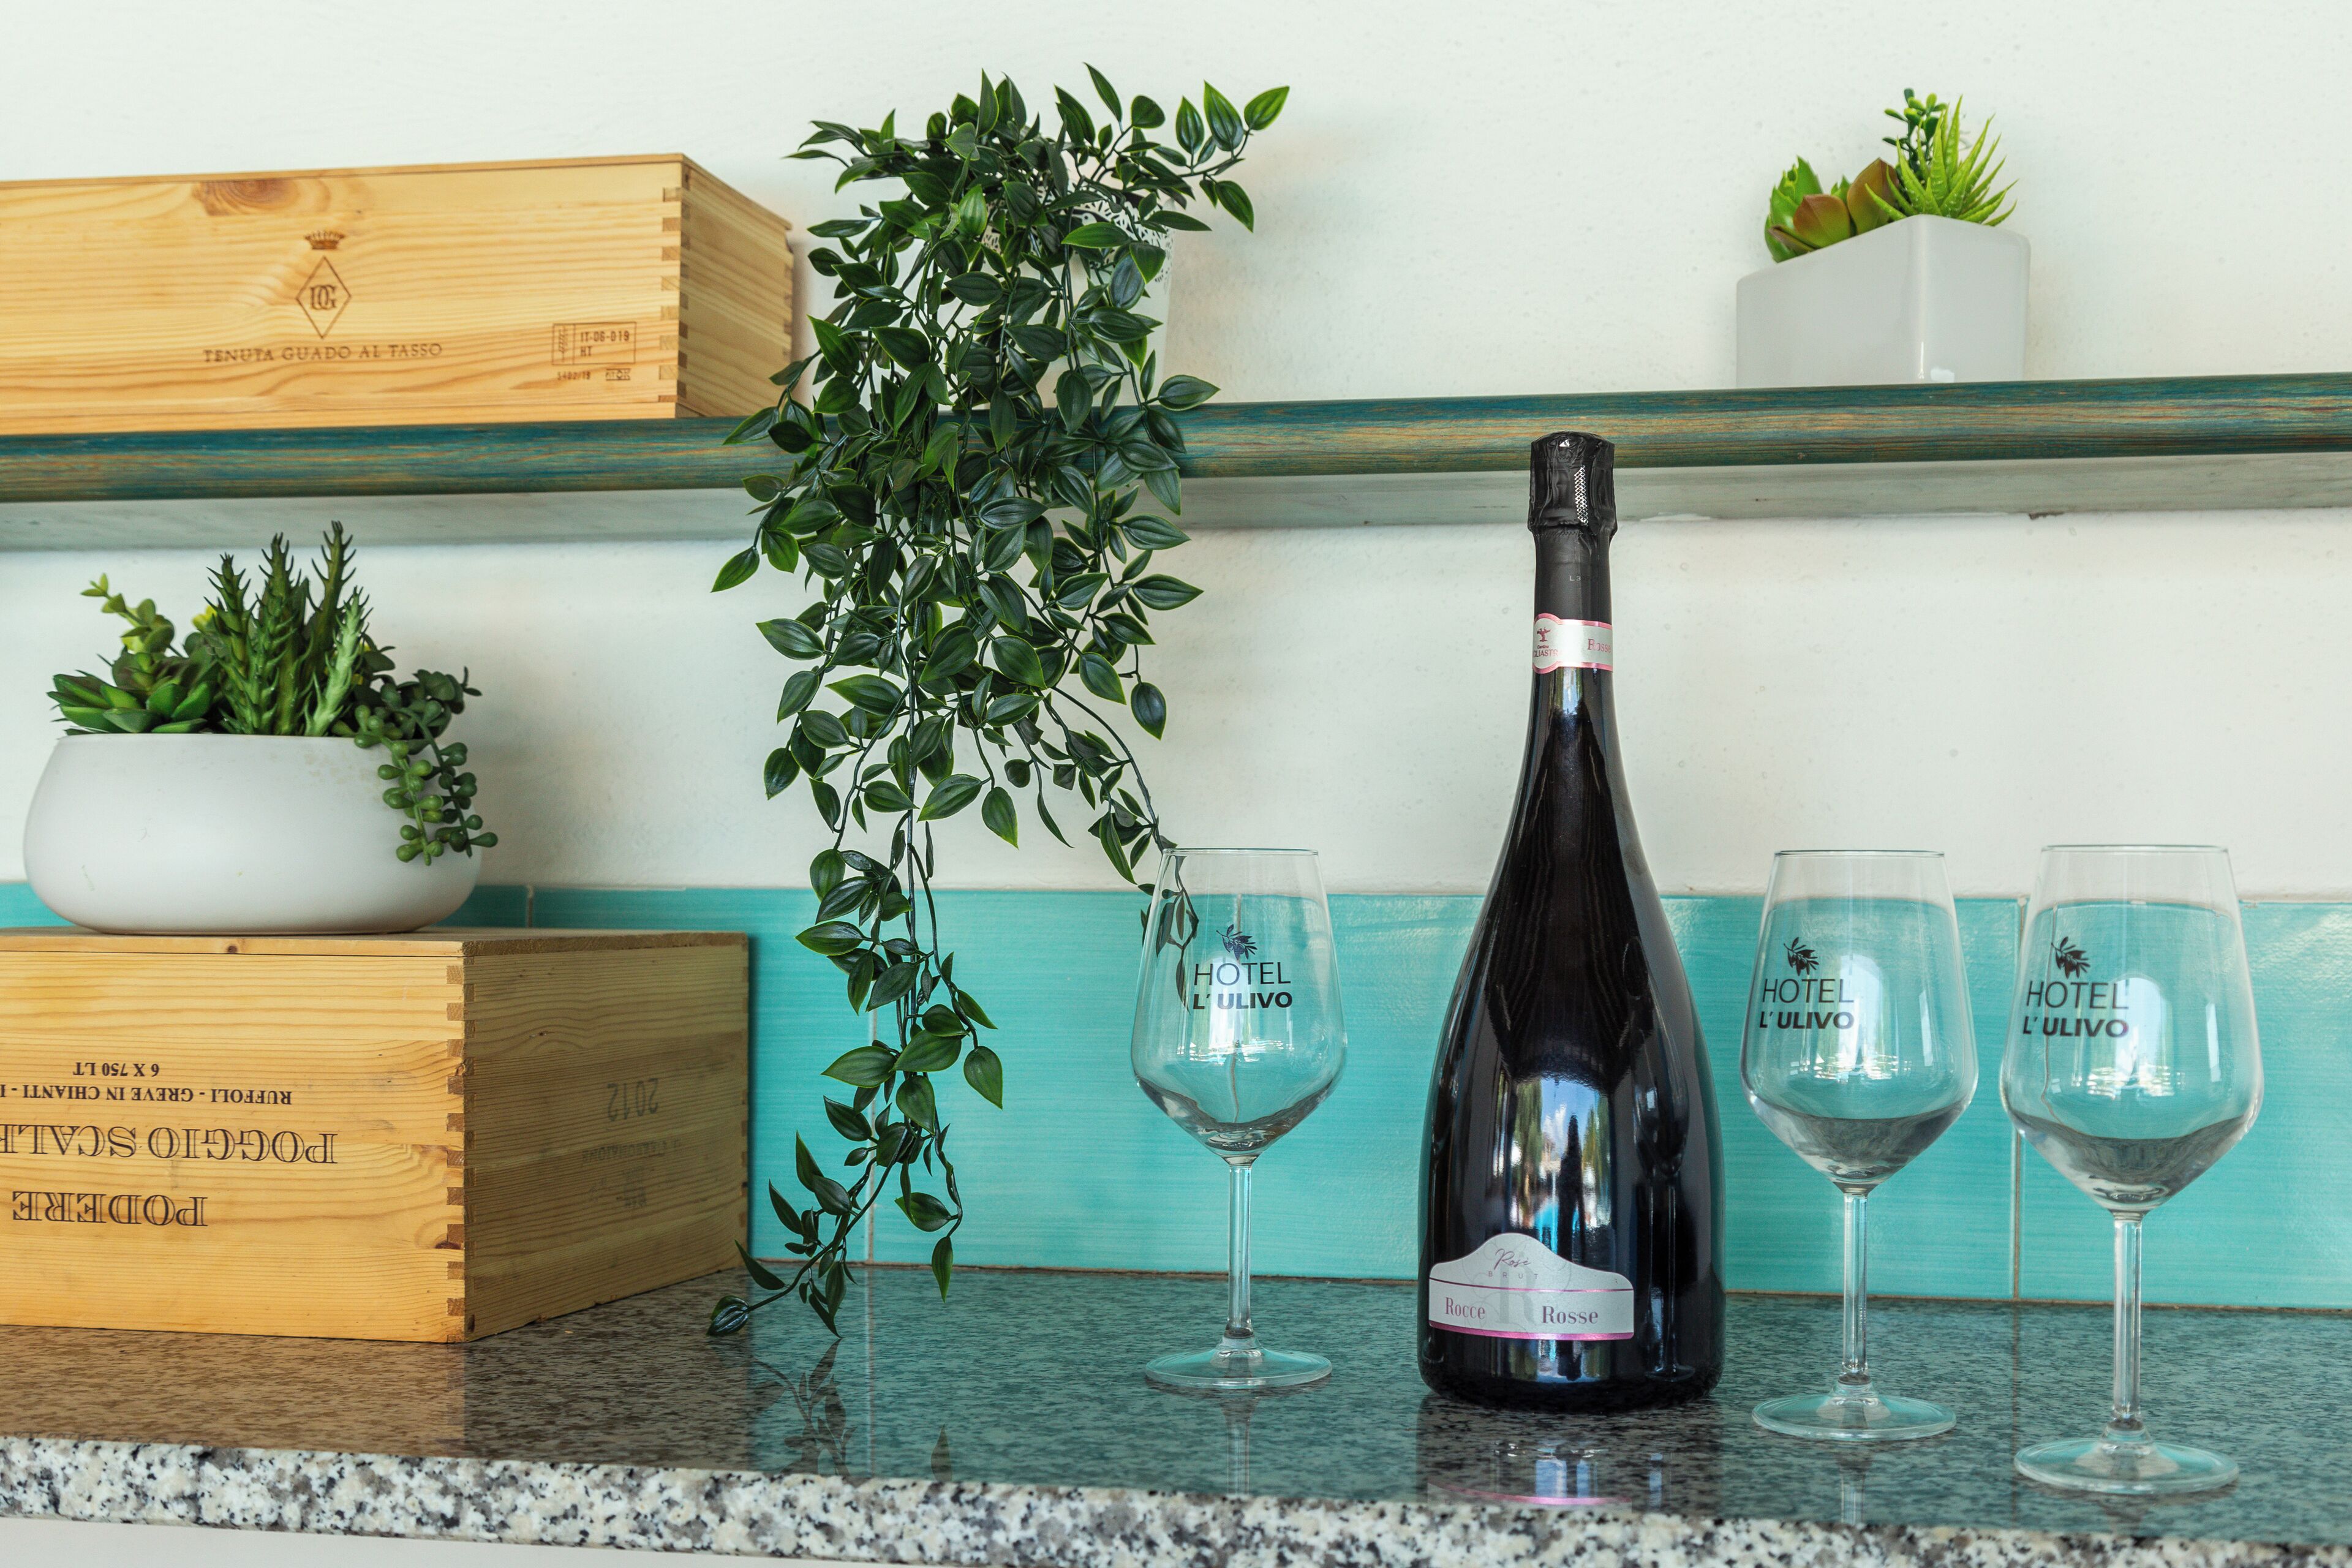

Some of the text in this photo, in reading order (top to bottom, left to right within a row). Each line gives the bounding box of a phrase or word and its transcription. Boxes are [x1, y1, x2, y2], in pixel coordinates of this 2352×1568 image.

[203, 343, 443, 362] TENUTA GUADO AL TASSO
[581, 345, 592, 356] HT
[1194, 962, 1291, 986] HOTEL
[1762, 979, 1854, 1003] HOTEL
[2026, 980, 2129, 1009] HOTEL
[72, 1061, 159, 1077] 6 X 750 LT
[22, 1085, 100, 1100] CHIANTI
[107, 1087, 124, 1101] IN
[131, 1087, 194, 1102] GREVE
[211, 1088, 292, 1105] RUFFOLI
[607, 1078, 658, 1121] 2012
[148, 1127, 338, 1164] POGGIO
[12, 1190, 208, 1226] PODERE
[1488, 1271, 1539, 1280] BRUT
[1445, 1297, 1599, 1324] Rocce Rosse
